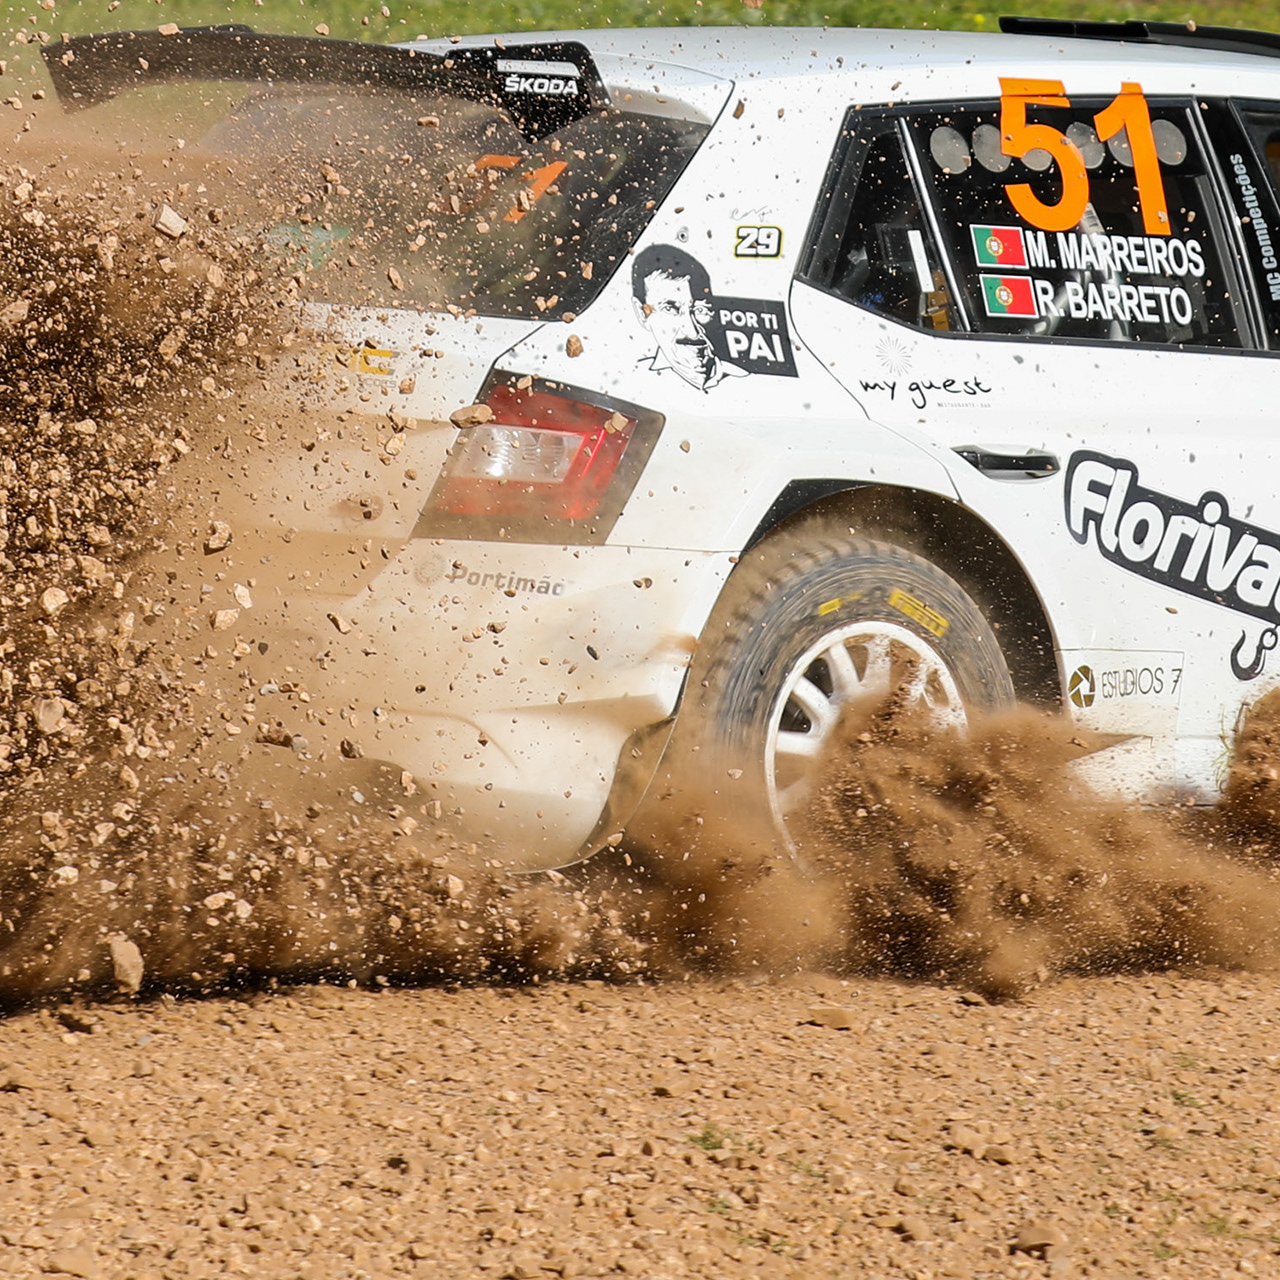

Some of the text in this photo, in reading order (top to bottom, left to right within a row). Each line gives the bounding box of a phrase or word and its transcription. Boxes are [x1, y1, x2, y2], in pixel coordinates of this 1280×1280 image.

[504, 73, 579, 95] ŠKODA
[998, 77, 1171, 235] 51
[1230, 153, 1278, 269] Competições
[736, 226, 782, 257] 29
[1025, 230, 1205, 277] M. MARREIROS
[1035, 280, 1192, 325] R. BARRETO
[720, 310, 778, 330] POR TI
[725, 330, 785, 362] PAI
[859, 376, 992, 410] my guest
[447, 565, 565, 597] Portimão
[1102, 667, 1182, 698] ESTUDIOS 7
